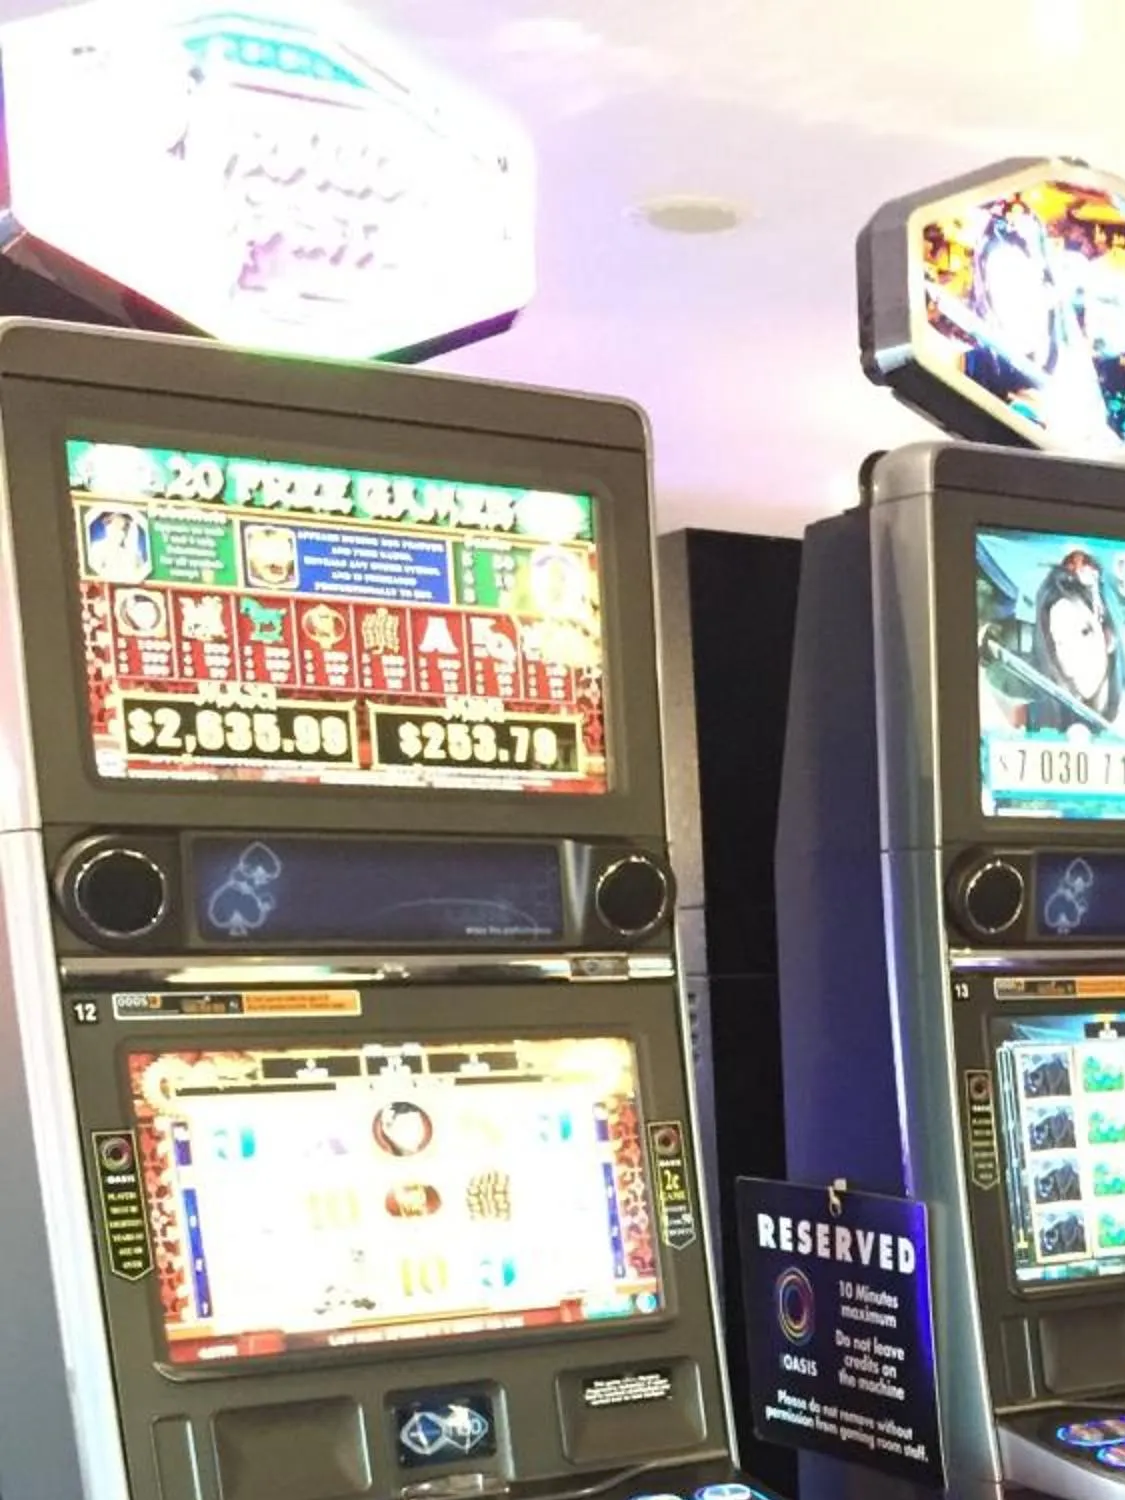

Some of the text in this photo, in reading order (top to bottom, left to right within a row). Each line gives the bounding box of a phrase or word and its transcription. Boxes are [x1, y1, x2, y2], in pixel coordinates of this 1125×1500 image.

[75, 1003, 96, 1022] 12
[757, 1213, 916, 1274] RESERVED
[839, 1280, 899, 1309] 10 Minutes
[841, 1305, 897, 1329] maximum
[835, 1330, 904, 1361] Do not leave
[783, 1354, 818, 1377] OASIS
[844, 1355, 897, 1378] credits on
[838, 1368, 905, 1400] the machine
[765, 1405, 815, 1429] permission
[816, 1417, 838, 1435] from
[876, 1437, 902, 1455] room
[777, 1390, 914, 1441] Please do not remove without
